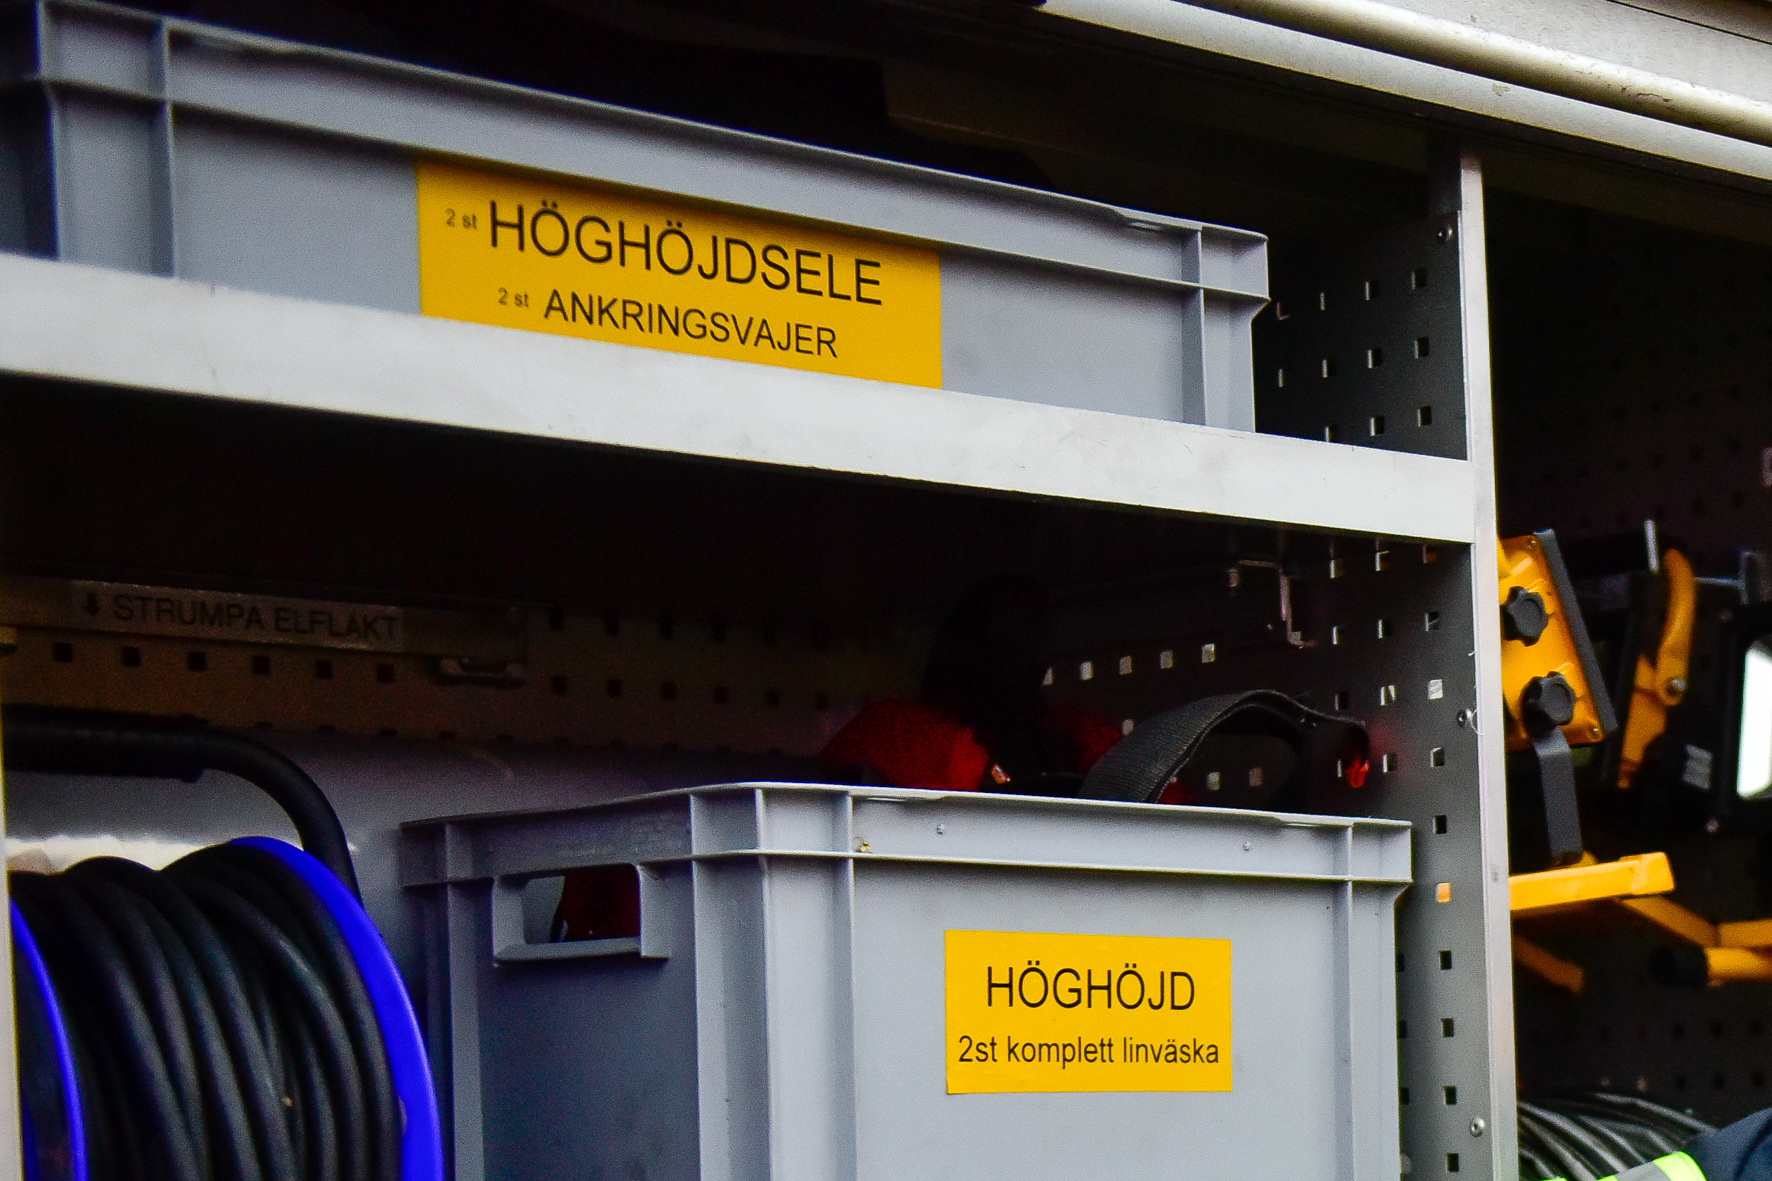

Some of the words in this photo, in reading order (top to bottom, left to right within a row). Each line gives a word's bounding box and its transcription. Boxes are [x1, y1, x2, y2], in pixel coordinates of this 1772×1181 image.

[444, 208, 458, 228] 2
[461, 213, 478, 230] st
[489, 199, 883, 306] HÖGHÖJDSELE
[497, 287, 509, 305] 2
[513, 291, 530, 309] st
[543, 288, 838, 358] ANKRINGSVAJER
[112, 593, 266, 633] STRUMPA
[273, 610, 400, 641] ELFLAKT
[986, 959, 1196, 1011] HÖGHÖJD
[957, 1034, 999, 1063] 2st
[1006, 1035, 1115, 1070] komplett
[1122, 1036, 1220, 1064] linväska
